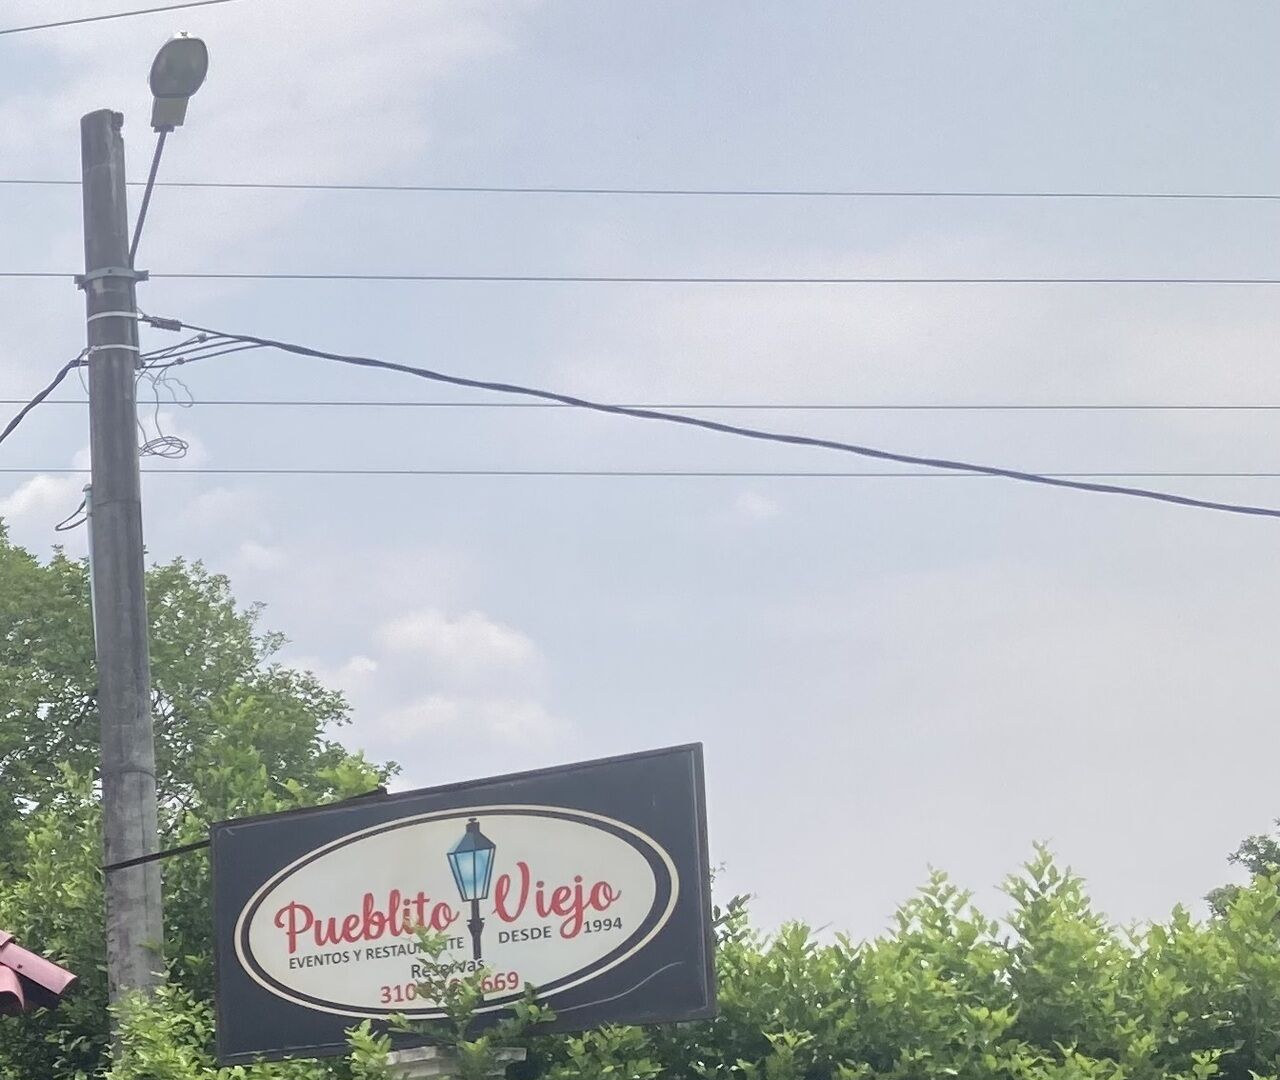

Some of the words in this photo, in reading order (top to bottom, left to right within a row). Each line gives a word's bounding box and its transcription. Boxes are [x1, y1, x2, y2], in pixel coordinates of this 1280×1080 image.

[274, 888, 460, 954] Pueblito
[492, 861, 622, 939] Viejo
[498, 925, 552, 944] DESDE
[583, 917, 623, 934] 1994
[289, 951, 350, 969] EVENTOS
[353, 949, 362, 961] Y
[366, 936, 465, 960] RESTAUTE
